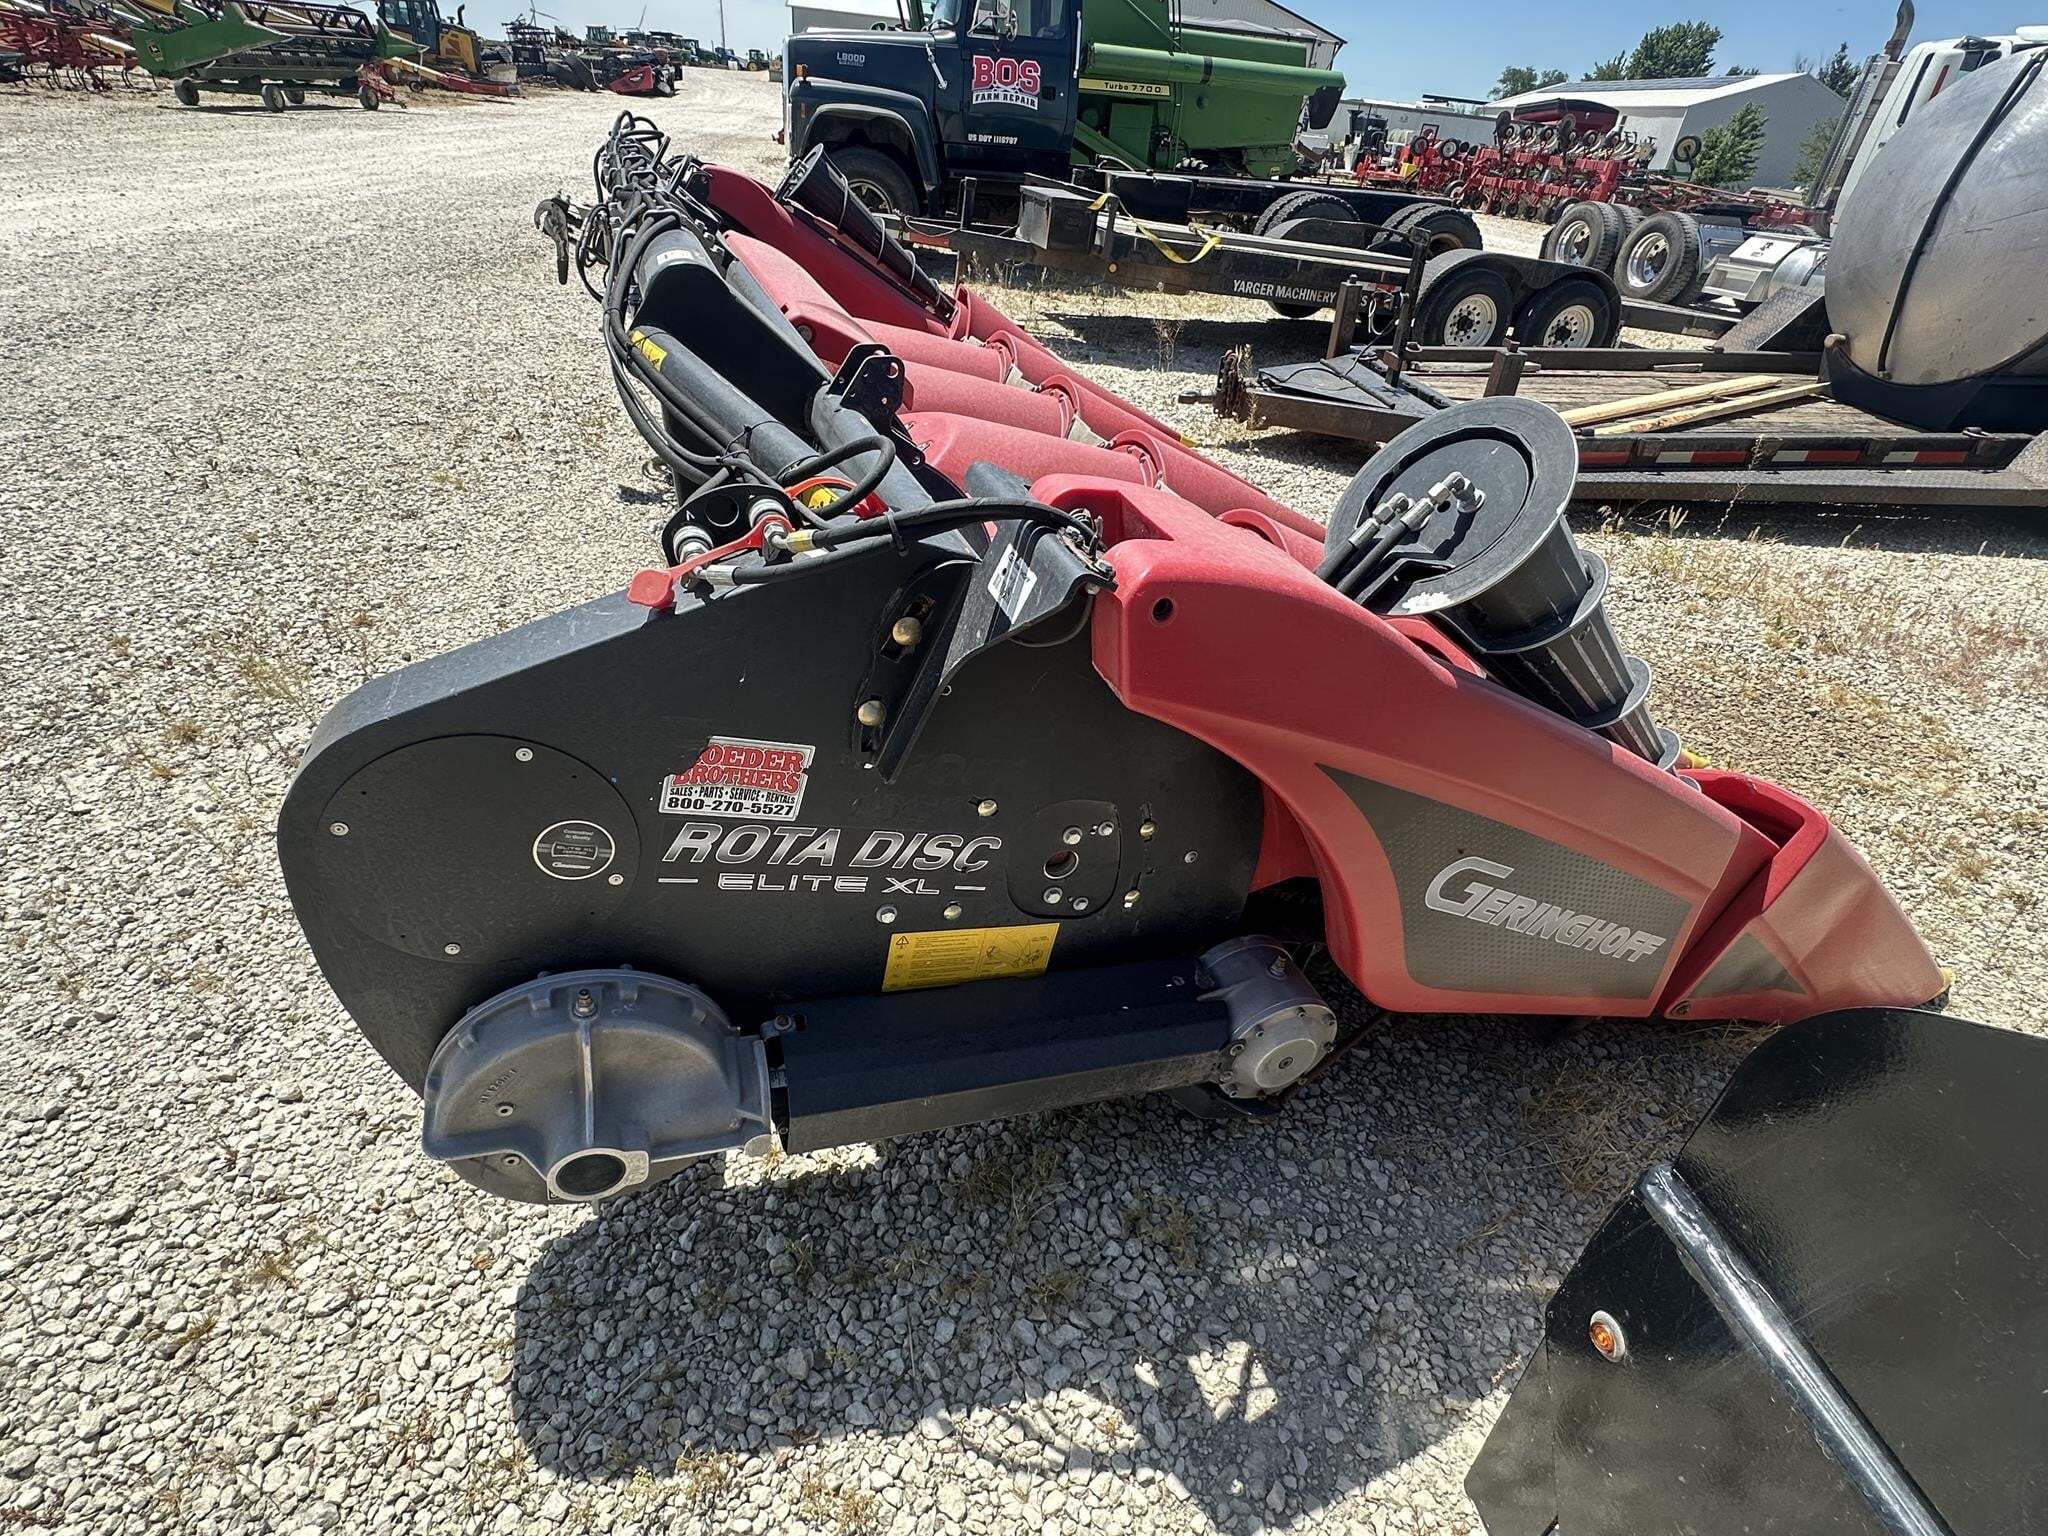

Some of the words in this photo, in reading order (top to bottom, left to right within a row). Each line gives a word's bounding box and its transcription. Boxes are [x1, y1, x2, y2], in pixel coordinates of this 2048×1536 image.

[972, 55, 1041, 96] BOS
[1104, 82, 1129, 91] Turbo
[1132, 84, 1162, 93] 7700
[974, 91, 1000, 102] FARM
[1003, 91, 1036, 108] REPAIR
[967, 133, 977, 142] US
[978, 134, 993, 143] DOT
[1233, 279, 1274, 297] YARGER
[1275, 285, 1337, 304] MACHINERY
[699, 743, 805, 773] OEDER
[672, 764, 801, 795] BROTHERS
[667, 797, 794, 816] 800-270-5527
[669, 786, 693, 797] SALES
[700, 786, 724, 799] PARTS
[730, 787, 761, 802] SERVICE
[766, 793, 796, 804] RENTALS
[661, 821, 841, 867] ROTA
[849, 830, 1002, 873] DISC
[717, 872, 869, 895] ELITE
[881, 876, 940, 895] XL
